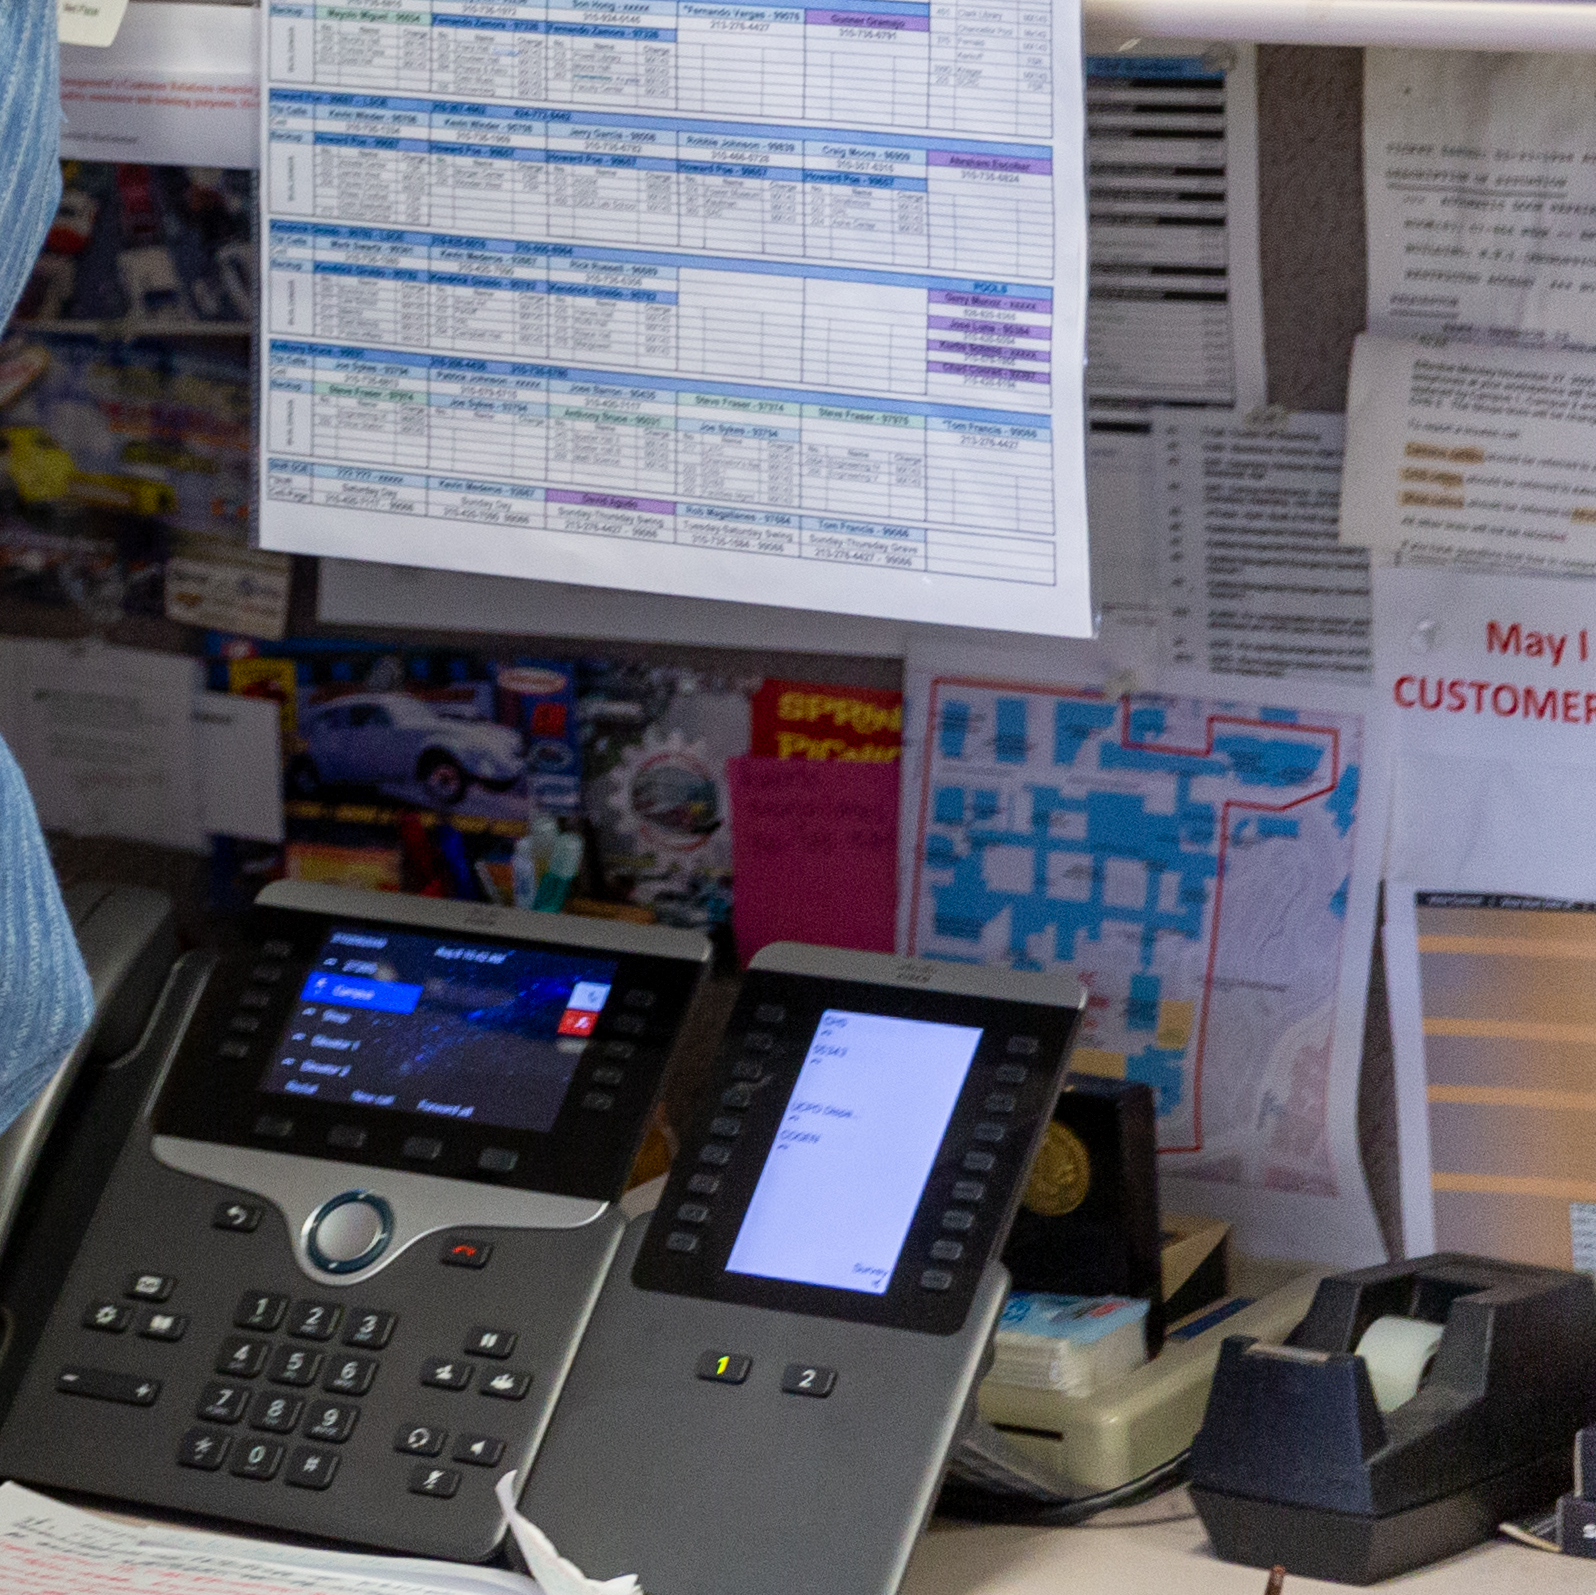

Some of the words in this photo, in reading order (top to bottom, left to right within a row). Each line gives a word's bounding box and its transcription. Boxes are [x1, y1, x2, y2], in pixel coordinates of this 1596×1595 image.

[1486, 620, 1568, 667] May
[308, 1306, 324, 1325] 2
[360, 1314, 378, 1333] 3
[233, 1344, 251, 1360] 4
[287, 1352, 305, 1370] 5
[341, 1361, 358, 1379] 6
[717, 1355, 730, 1375] 1
[799, 1369, 817, 1388] 2
[217, 1389, 234, 1405] 7
[267, 1398, 286, 1417] 8
[323, 1408, 340, 1426] 9
[248, 1445, 267, 1463] 0
